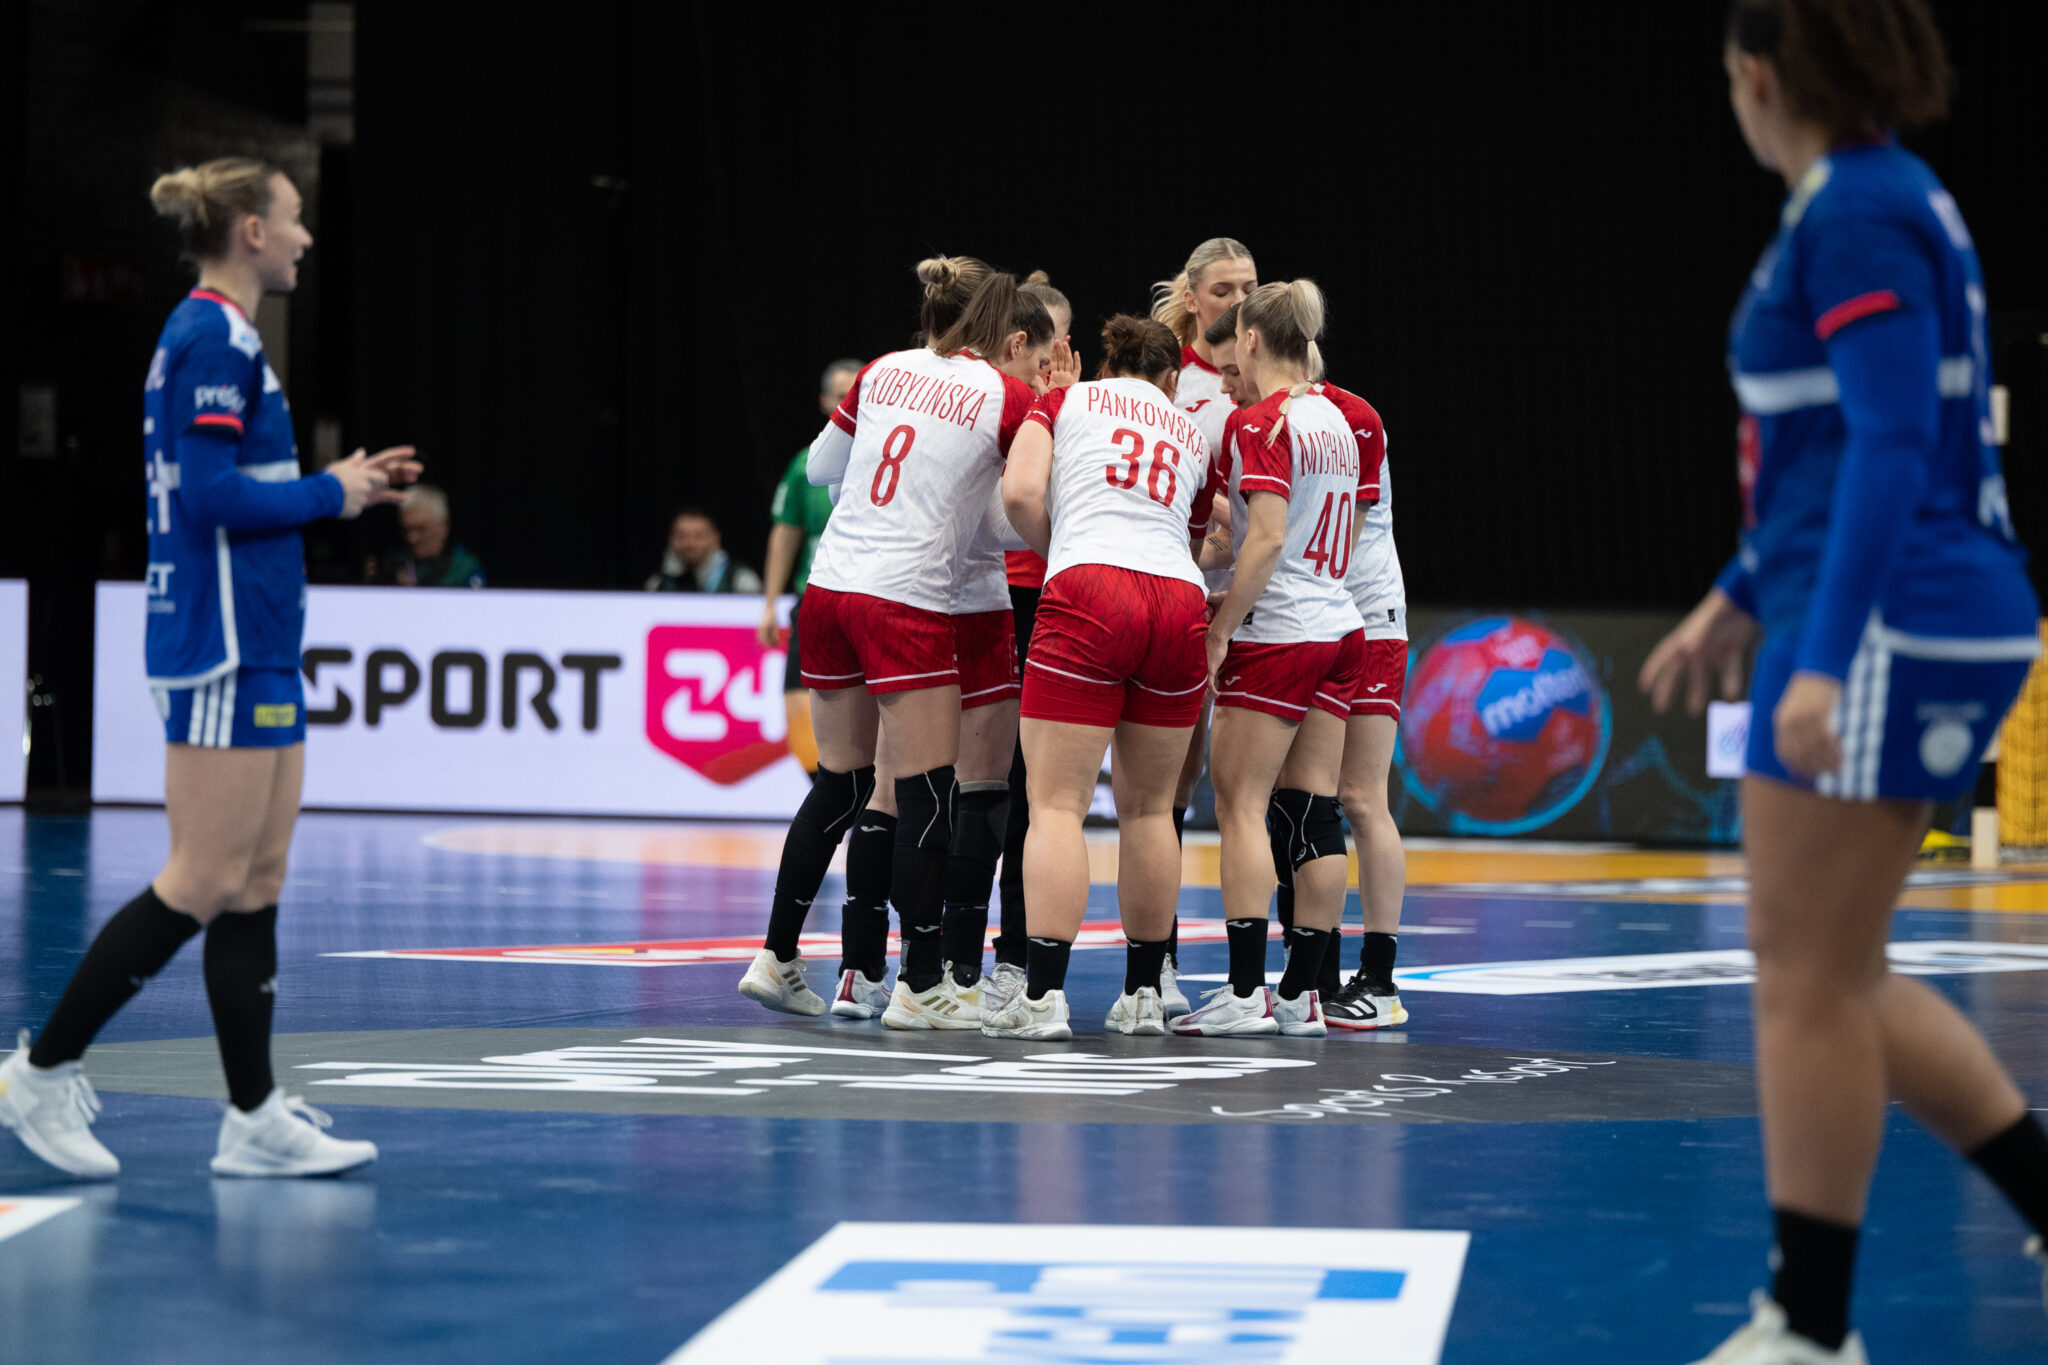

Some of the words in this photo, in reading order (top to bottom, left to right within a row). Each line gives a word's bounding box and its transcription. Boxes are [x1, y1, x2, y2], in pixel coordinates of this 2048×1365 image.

[865, 367, 987, 432] KOBYLIŃSKA
[1088, 386, 1204, 464] PANKOWSKA
[870, 424, 916, 507] 8
[1105, 427, 1181, 508] 36
[1302, 491, 1352, 580] 40
[302, 646, 622, 732] SPORT
[662, 648, 789, 743] 24
